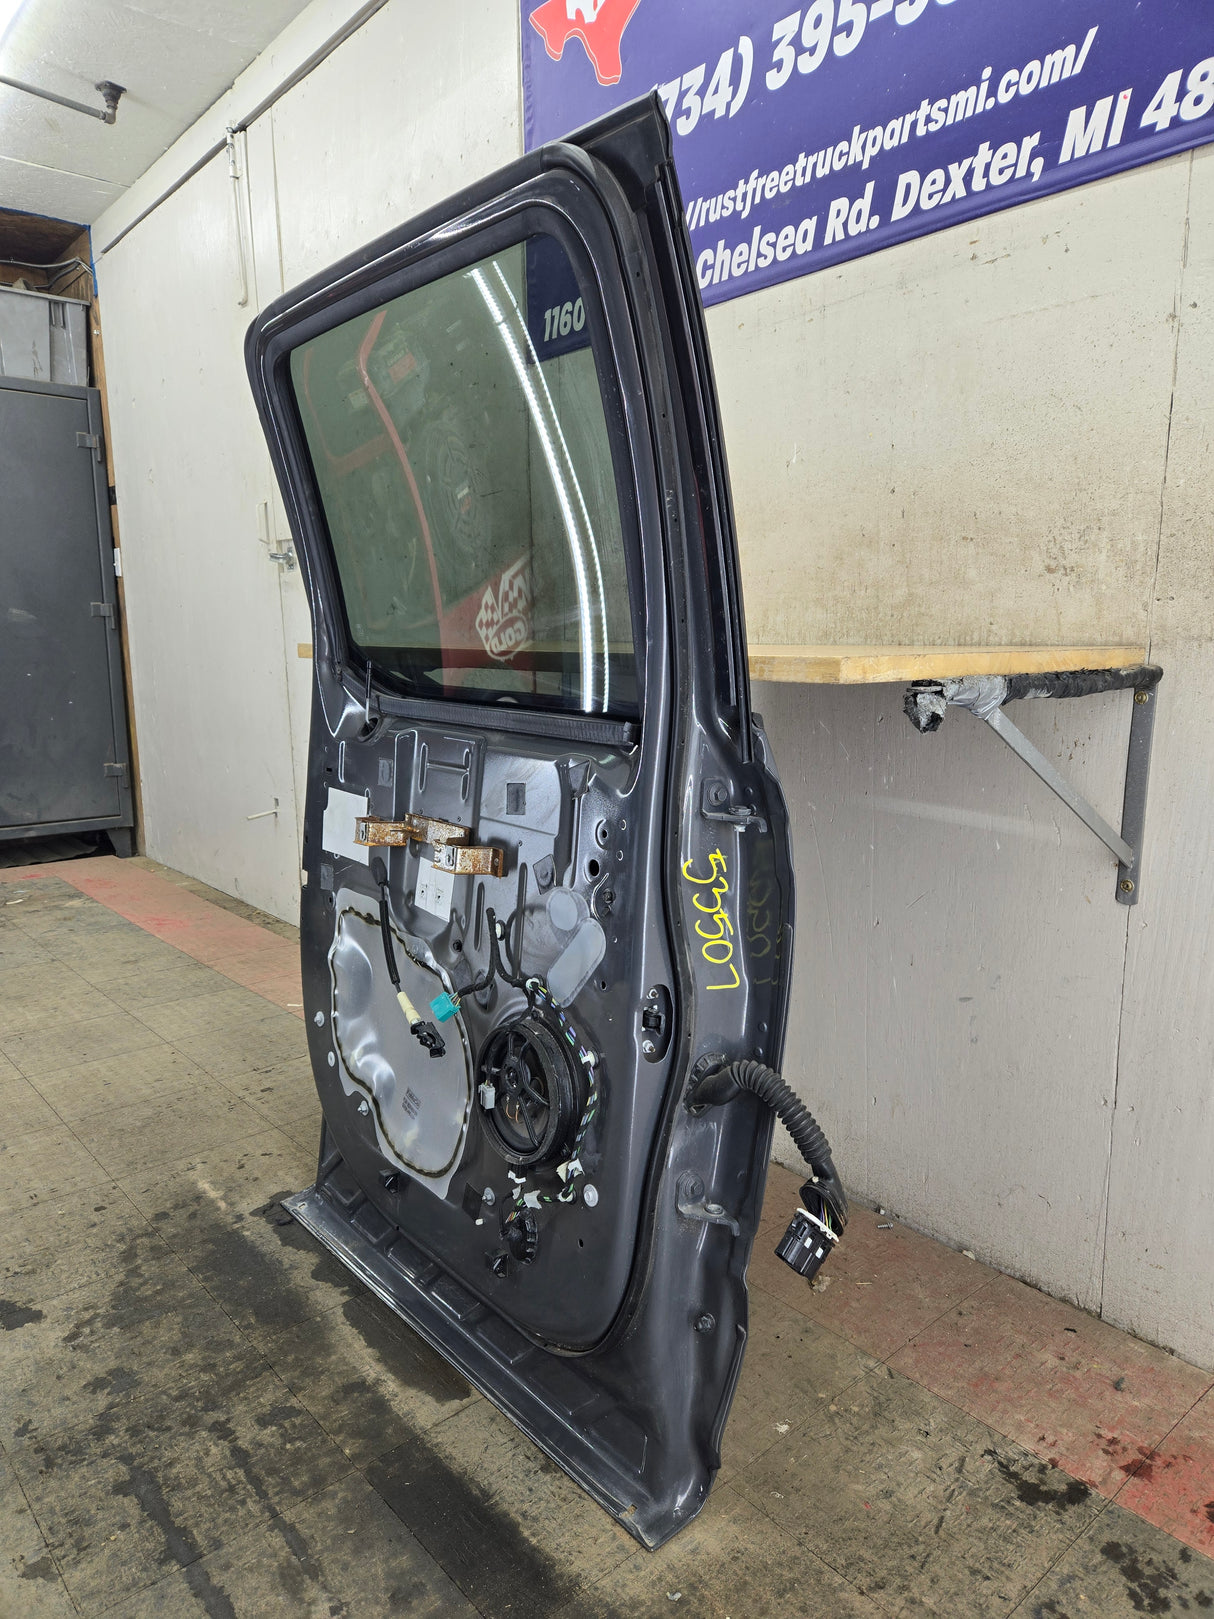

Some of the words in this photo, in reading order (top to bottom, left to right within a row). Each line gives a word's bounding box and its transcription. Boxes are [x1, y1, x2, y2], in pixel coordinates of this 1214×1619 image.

[650, 35, 754, 136] 734)
[765, 0, 957, 91] 395-
[543, 296, 586, 342] 1160
[696, 215, 818, 289] Chelsea
[823, 180, 881, 246] Rd.
[890, 131, 1042, 223] Dexter,
[1057, 87, 1133, 164] MI
